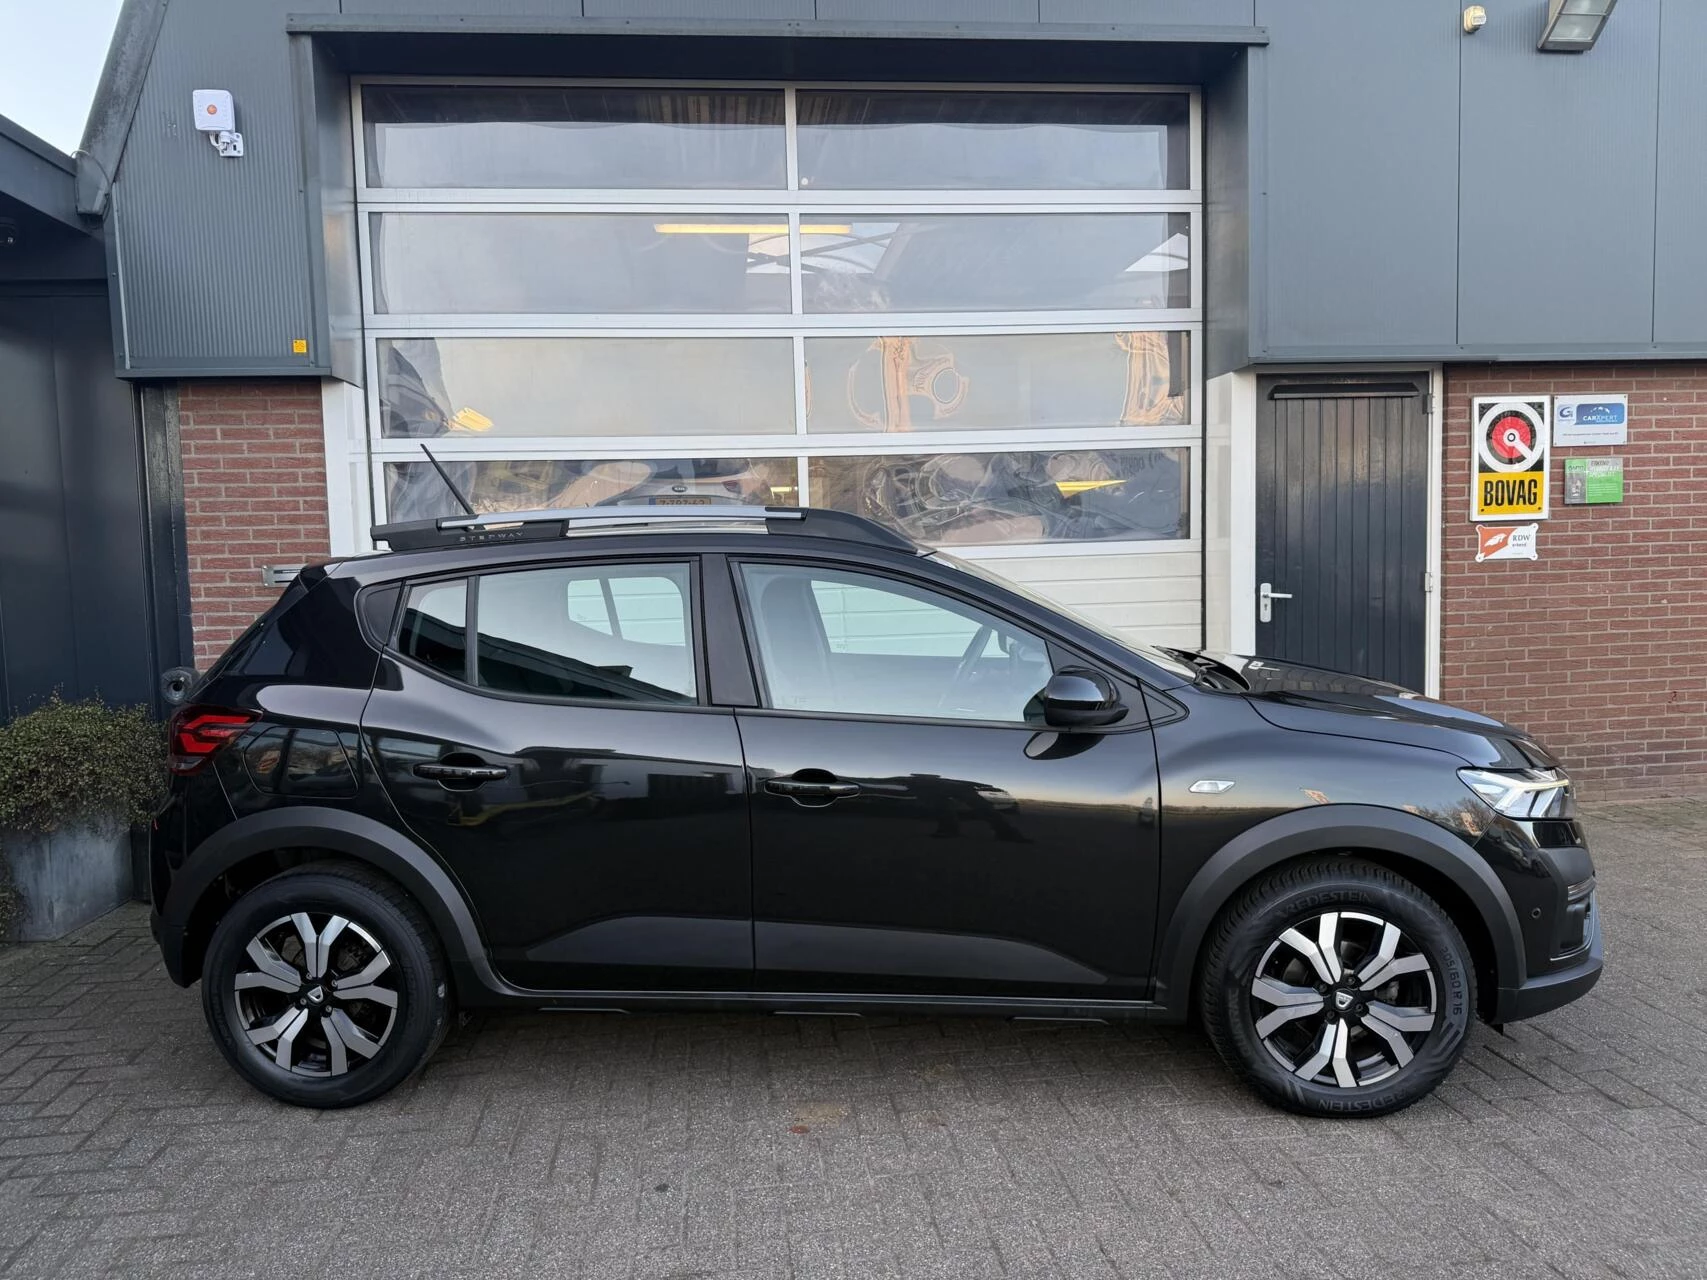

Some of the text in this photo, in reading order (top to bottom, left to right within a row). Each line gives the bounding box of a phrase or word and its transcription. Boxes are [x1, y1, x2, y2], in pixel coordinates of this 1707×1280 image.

[1483, 479, 1538, 507] BOVAG
[459, 531, 523, 542] STEPWAY
[1512, 534, 1530, 542] RDW
[1318, 1088, 1413, 1112] REDESTEIN
